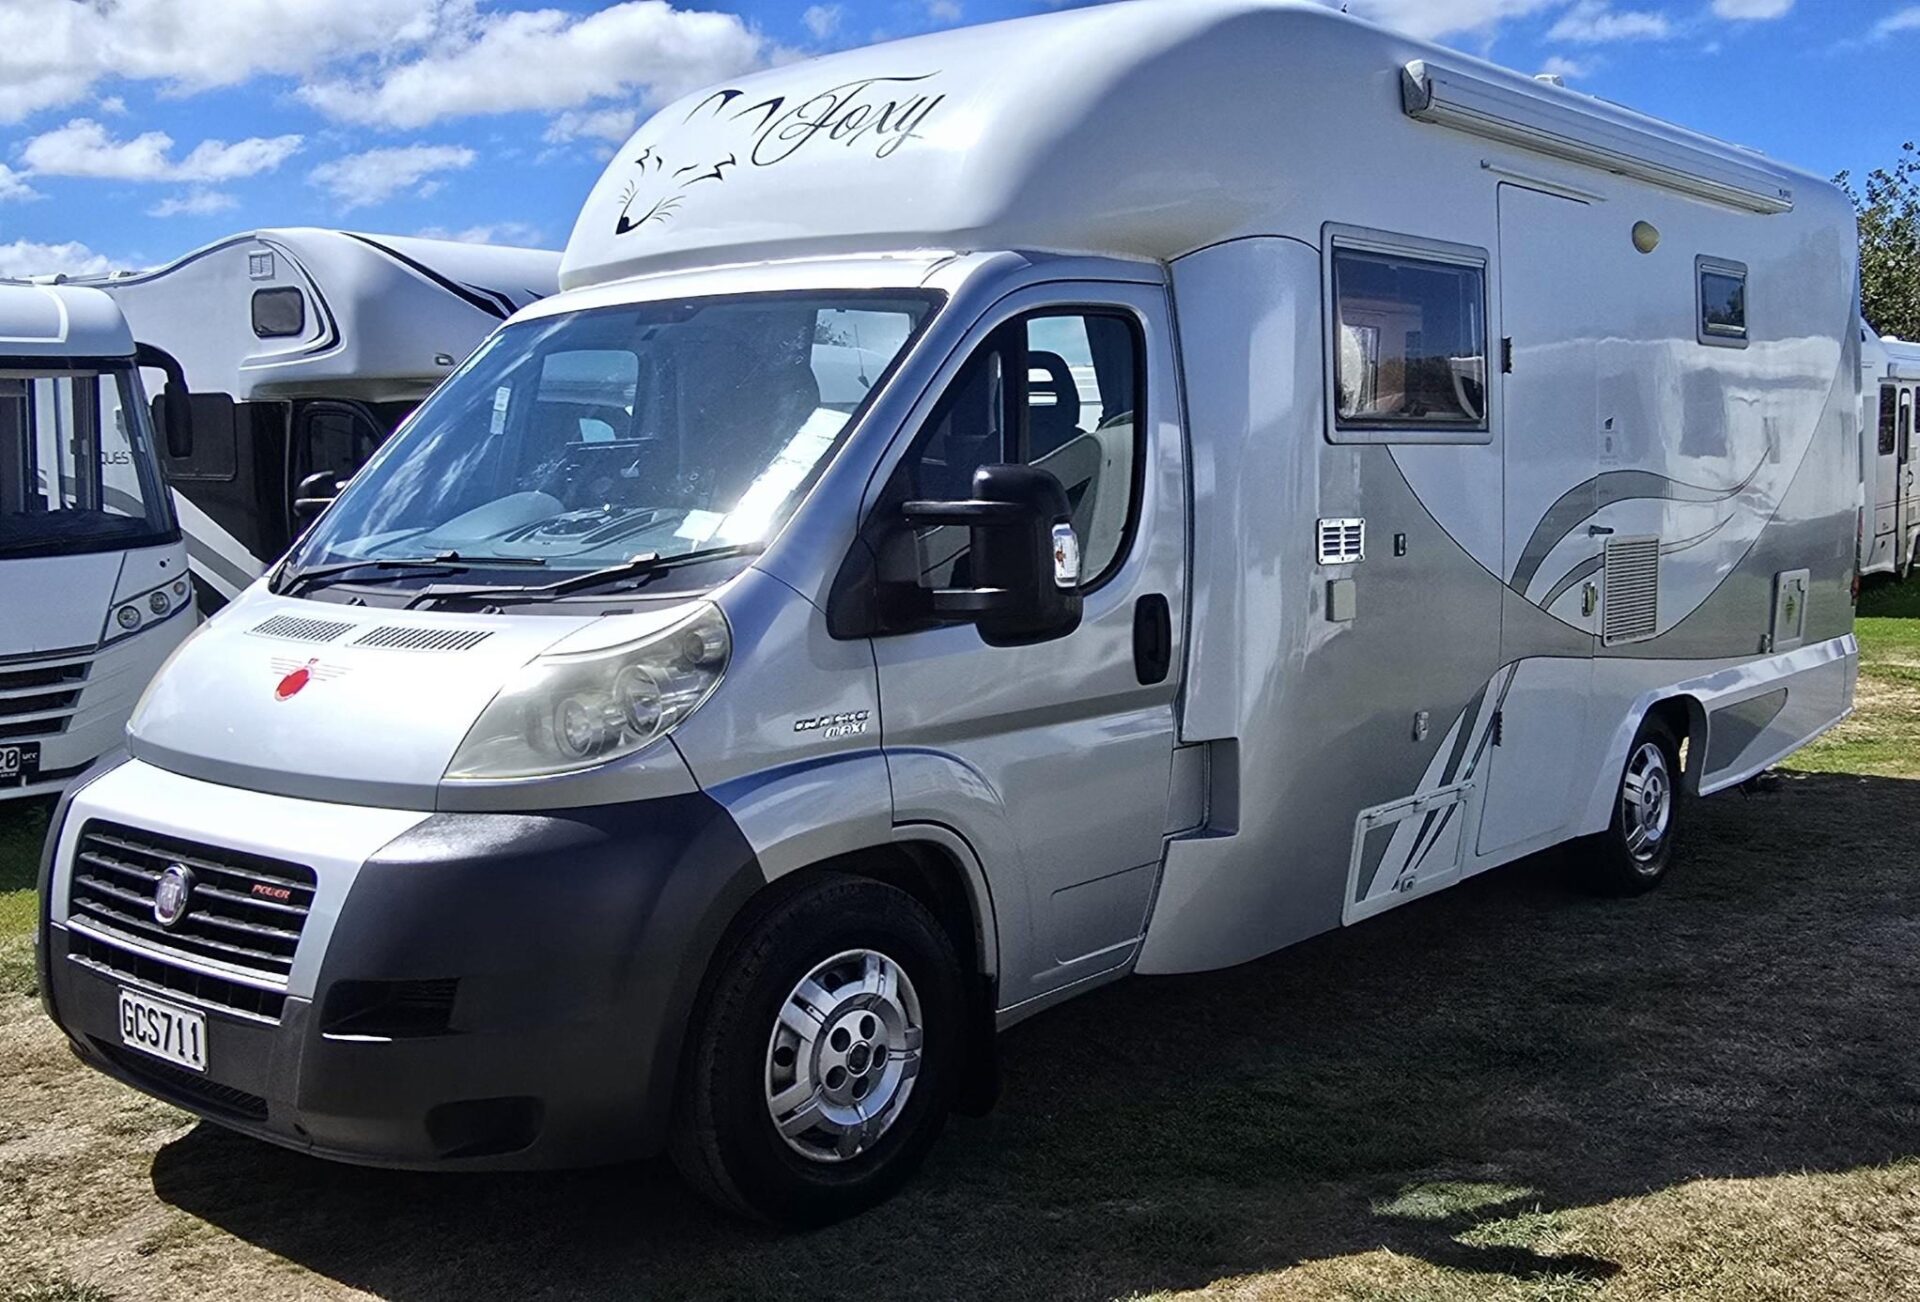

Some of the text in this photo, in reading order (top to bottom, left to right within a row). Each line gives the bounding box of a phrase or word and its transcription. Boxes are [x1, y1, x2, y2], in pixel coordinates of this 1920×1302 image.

[751, 69, 947, 167] Foxy
[823, 722, 867, 739] MAXI
[251, 884, 291, 899] POWER
[122, 998, 199, 1062] GCS711
